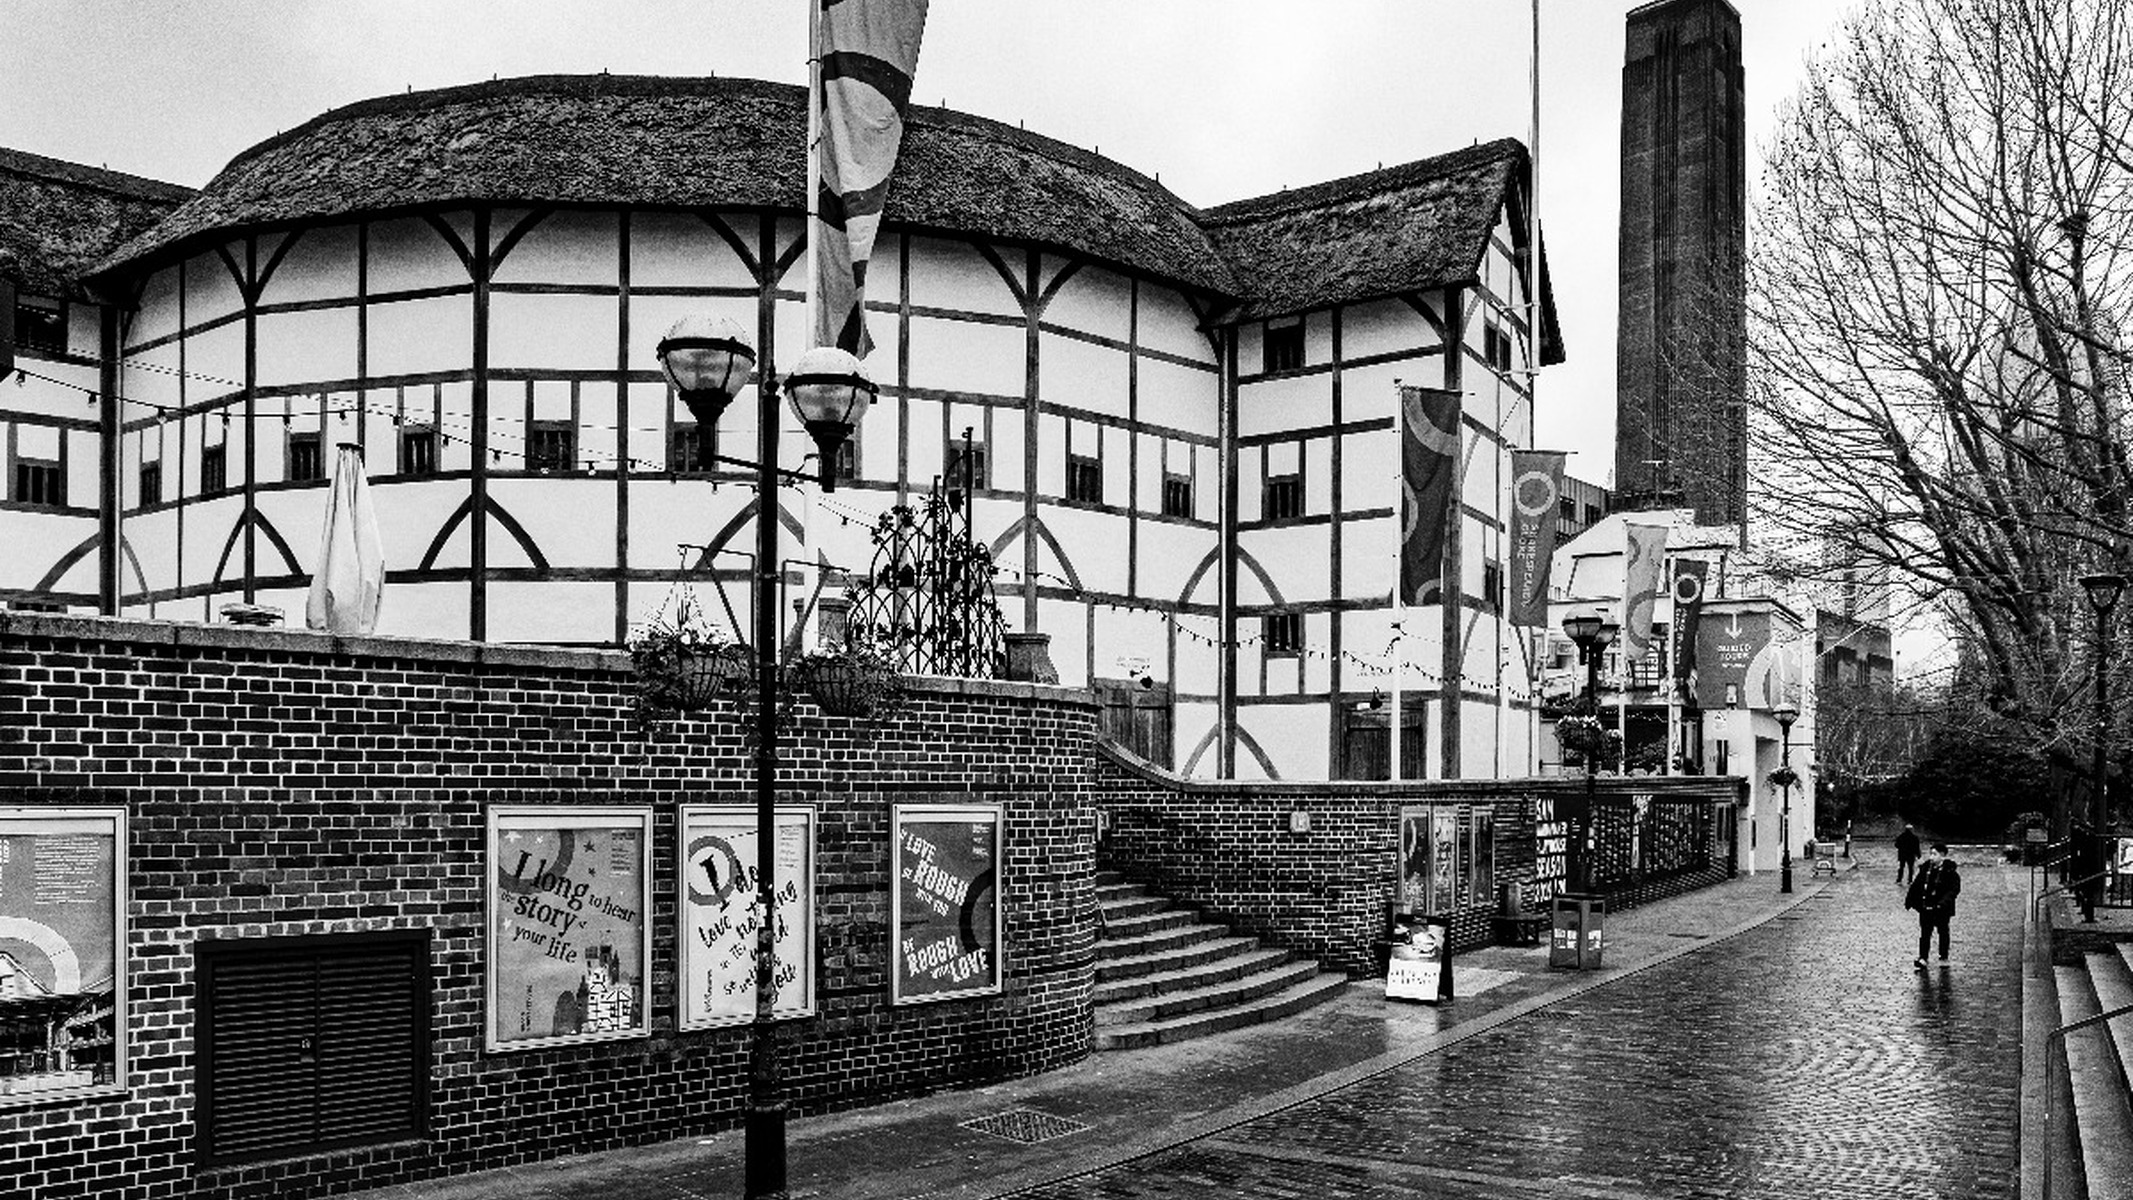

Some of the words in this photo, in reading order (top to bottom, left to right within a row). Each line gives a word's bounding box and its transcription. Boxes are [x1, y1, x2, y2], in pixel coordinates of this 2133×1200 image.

[905, 832, 937, 863] LOVE
[530, 859, 590, 911] long
[588, 894, 602, 908] to
[602, 896, 636, 922] hear
[912, 859, 970, 906] ROUGH
[514, 896, 578, 938] story
[513, 926, 547, 945] your
[545, 937, 577, 963] life
[907, 935, 959, 977] ROUGH
[950, 948, 989, 983] LOVE
